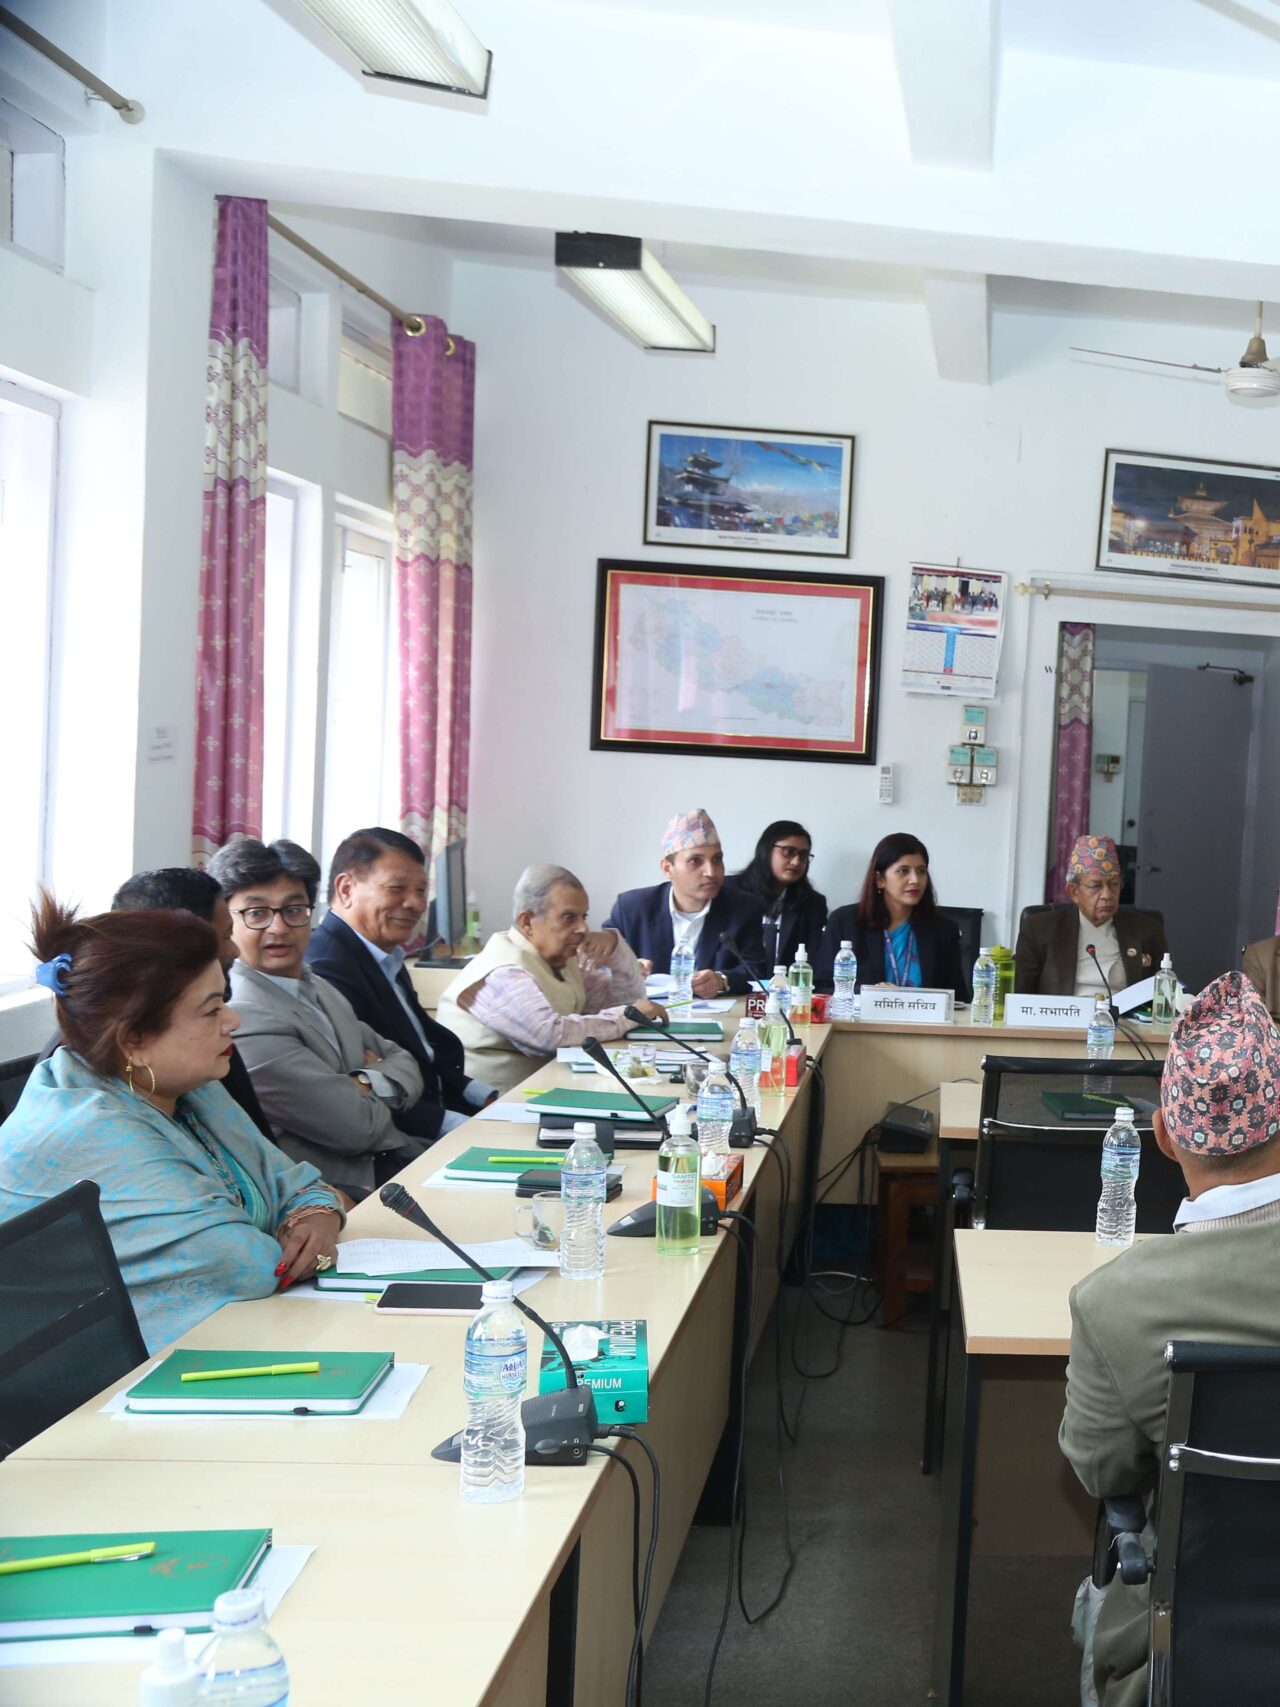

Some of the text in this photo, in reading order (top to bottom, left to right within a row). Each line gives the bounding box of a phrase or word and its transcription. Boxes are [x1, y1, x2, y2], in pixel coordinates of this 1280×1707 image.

[873, 999, 936, 1011] समिति सचिव
[1021, 1004, 1081, 1017] मा. सभापति
[576, 1378, 622, 1389] REMIUM
